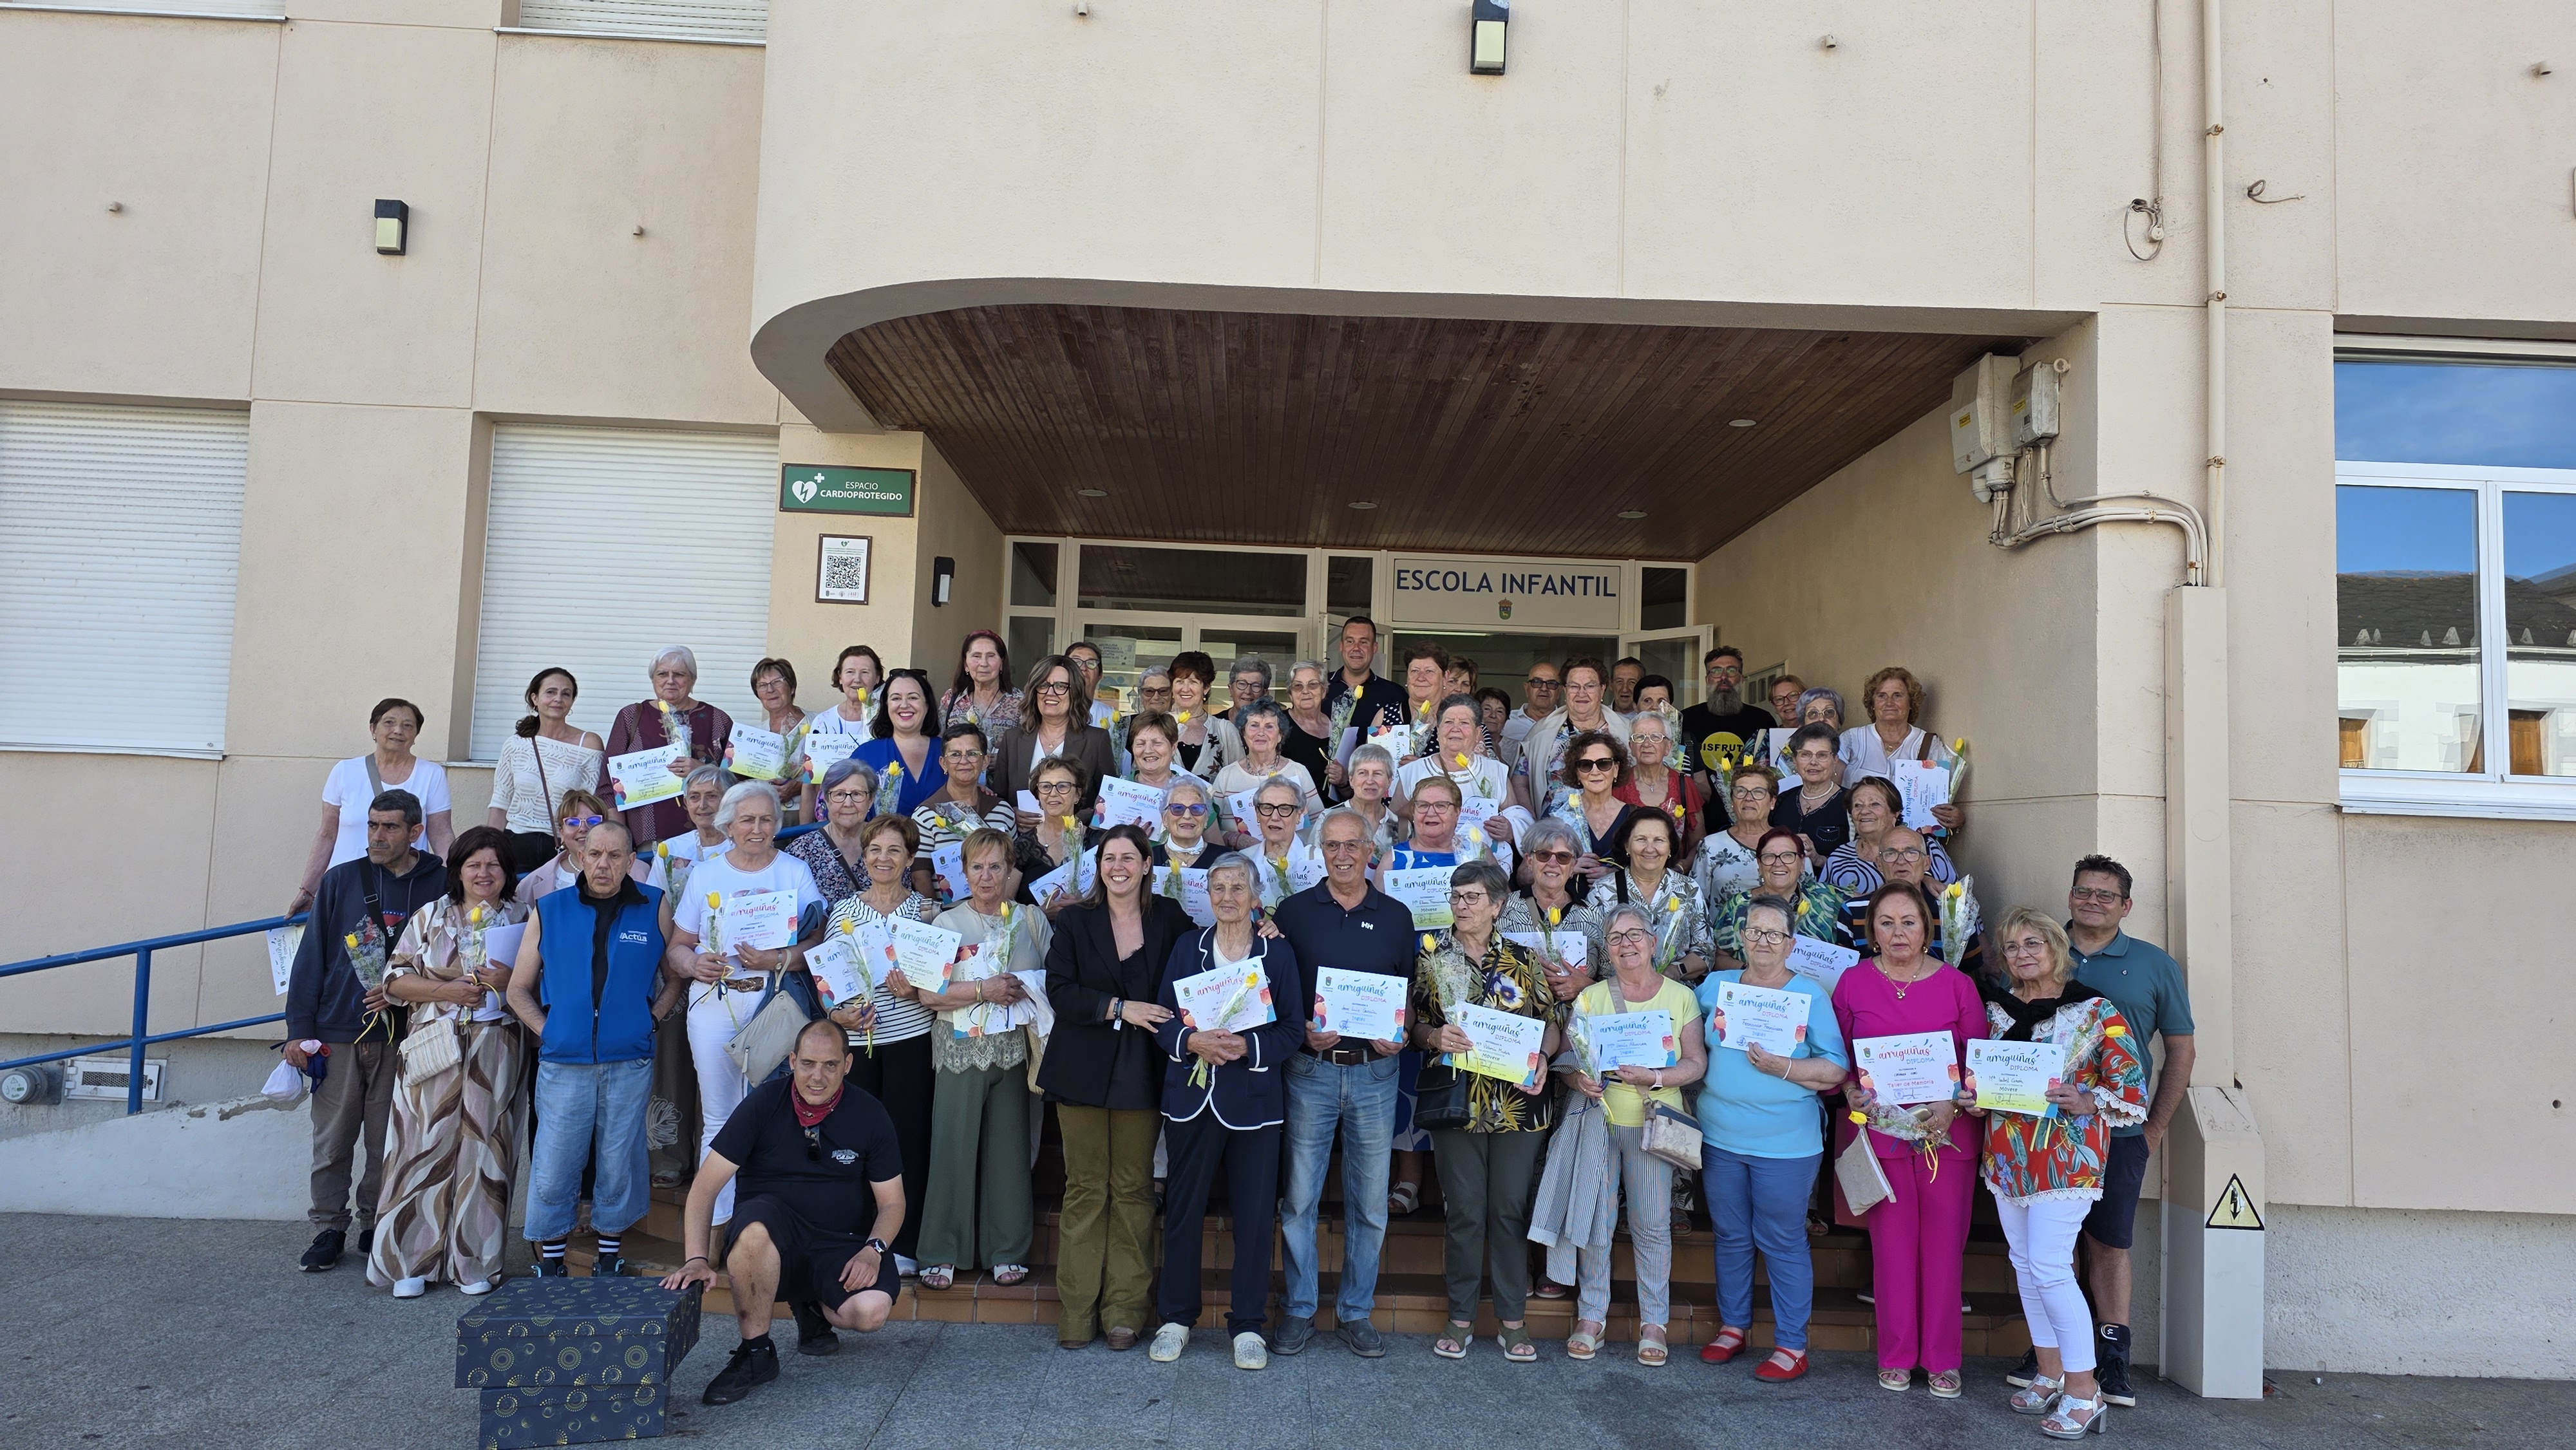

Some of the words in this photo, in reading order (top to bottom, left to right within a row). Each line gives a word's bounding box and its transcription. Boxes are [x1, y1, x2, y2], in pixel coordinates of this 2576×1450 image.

[820, 490, 902, 500] CARDIOPROTEGIDO
[1396, 569, 1493, 593] ESCOLA
[1502, 573, 1617, 597] INFANTIL
[1117, 791, 1157, 805] arruguiñas
[1136, 801, 1158, 810] DIPLOMA
[1405, 877, 1447, 890] arruguiñas
[731, 903, 777, 917] arruguiñas
[900, 932, 940, 949] arruguiñas
[918, 945, 940, 956] DIPLOMA
[1810, 959, 1835, 971] DIPLOMA
[1197, 976, 1244, 995] arruguiñas
[1337, 984, 1385, 997] arruguiñas
[1739, 1000, 1786, 1013] arruguiñas
[1762, 1011, 1788, 1019] DIPLOMA
[1472, 1020, 1520, 1038] arruguiñas
[1600, 1021, 1647, 1034] arruguiñas
[1495, 1034, 1521, 1044] DIPLOMA
[1879, 1046, 1931, 1061] arruguiñas
[1986, 1053, 2036, 1066] arruguiñas
